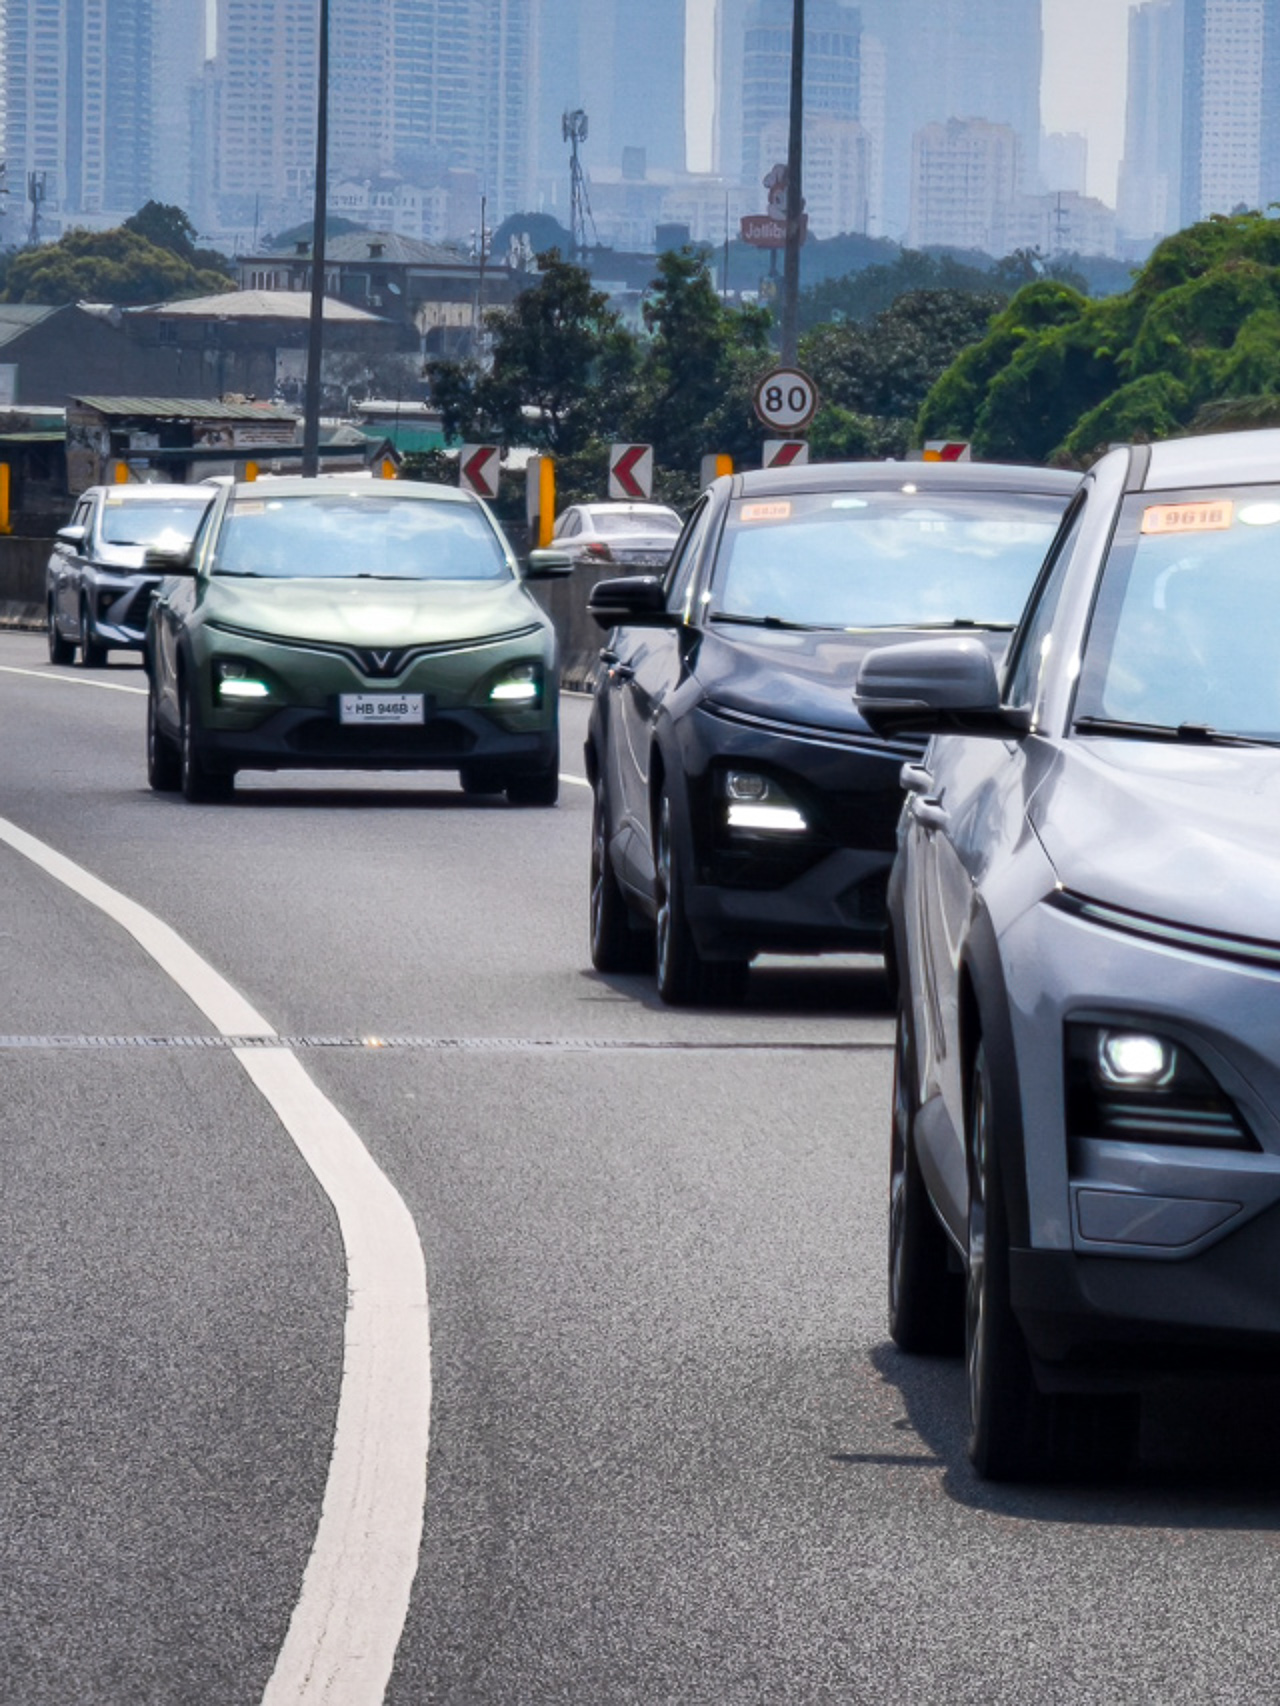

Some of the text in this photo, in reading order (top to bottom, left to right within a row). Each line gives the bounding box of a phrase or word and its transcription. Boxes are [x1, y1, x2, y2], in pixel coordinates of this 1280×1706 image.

[745, 221, 787, 239] Jollib
[765, 385, 807, 413] 80
[1165, 509, 1223, 526] 961B
[355, 703, 375, 715] HB
